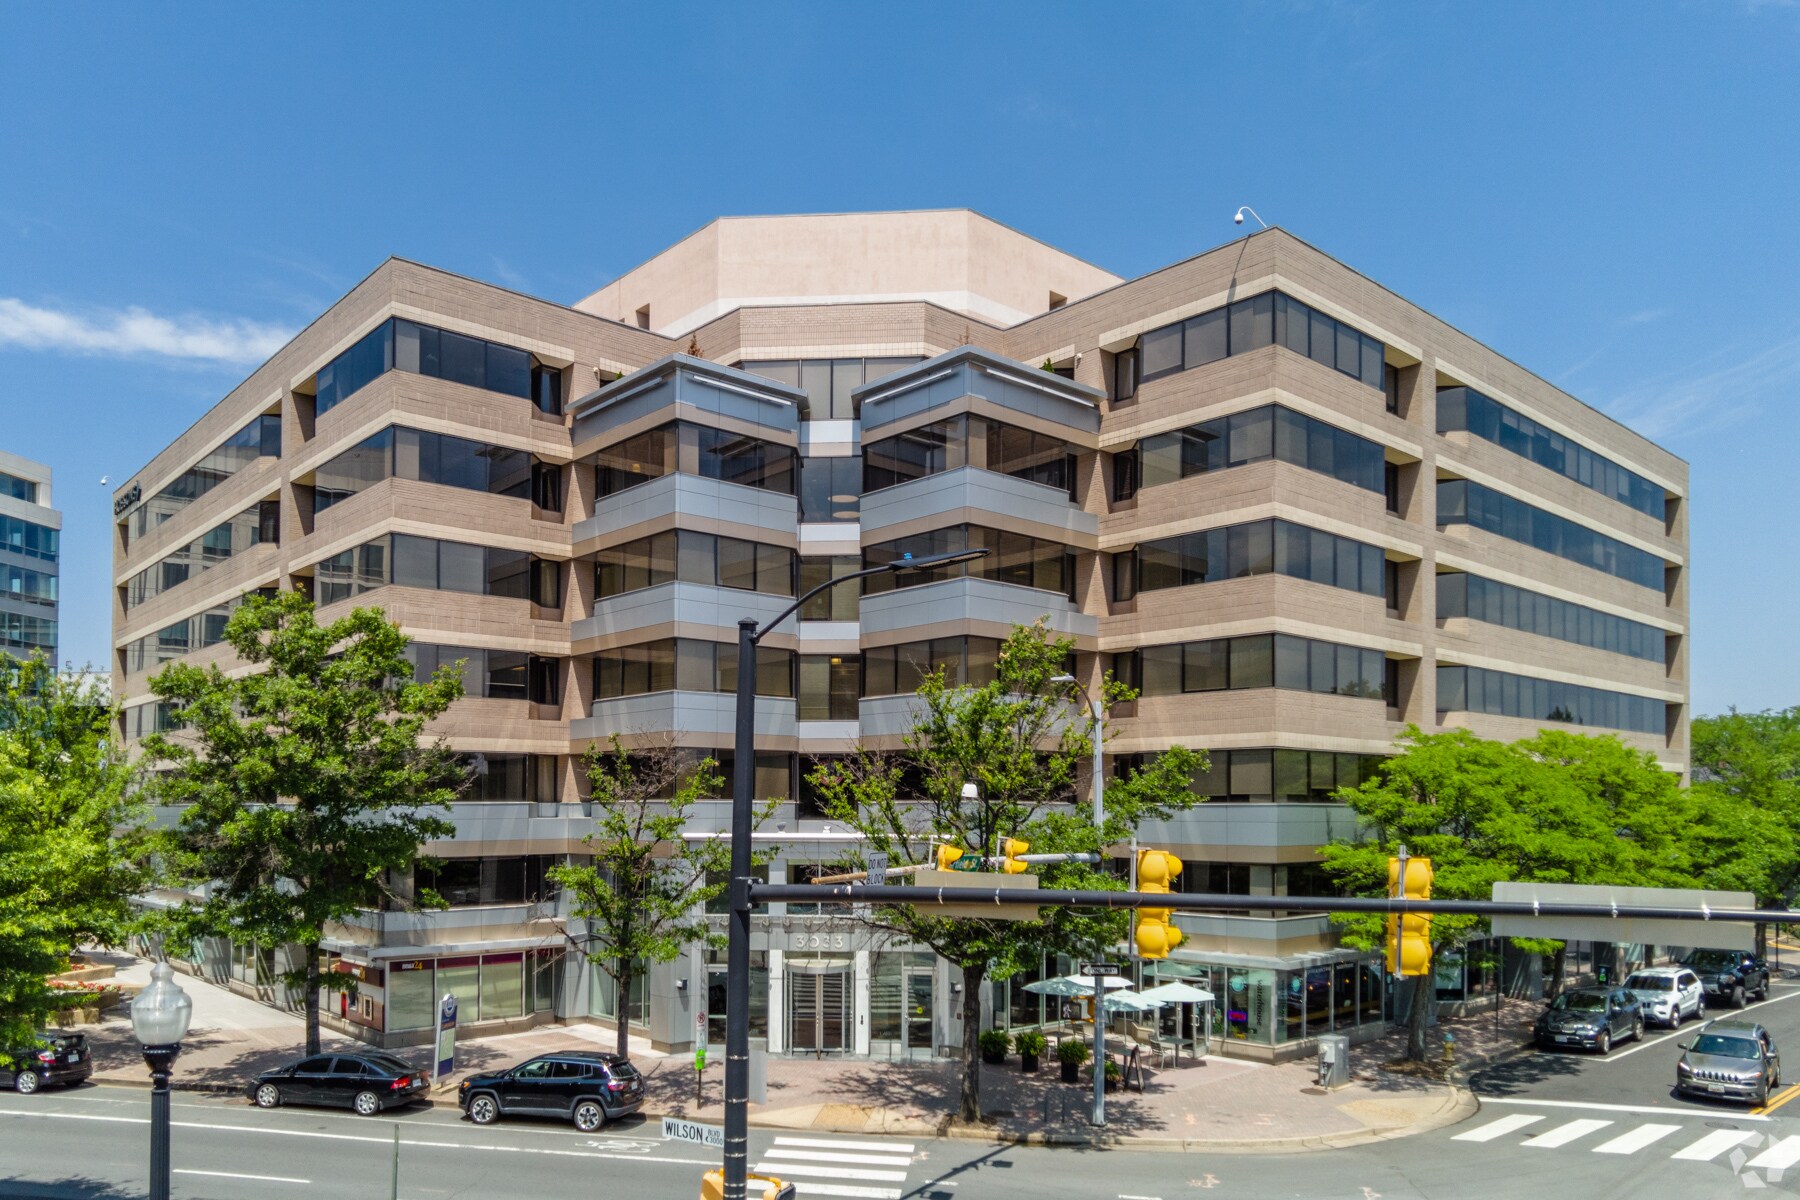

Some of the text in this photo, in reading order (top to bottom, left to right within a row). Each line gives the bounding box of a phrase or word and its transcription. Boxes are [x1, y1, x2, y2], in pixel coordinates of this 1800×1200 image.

[868, 858, 887, 870] DO NOT
[796, 935, 843, 948] 3033
[665, 1121, 703, 1142] WILSON
[707, 1128, 721, 1138] BLVD
[709, 1136, 724, 1146] 3000
